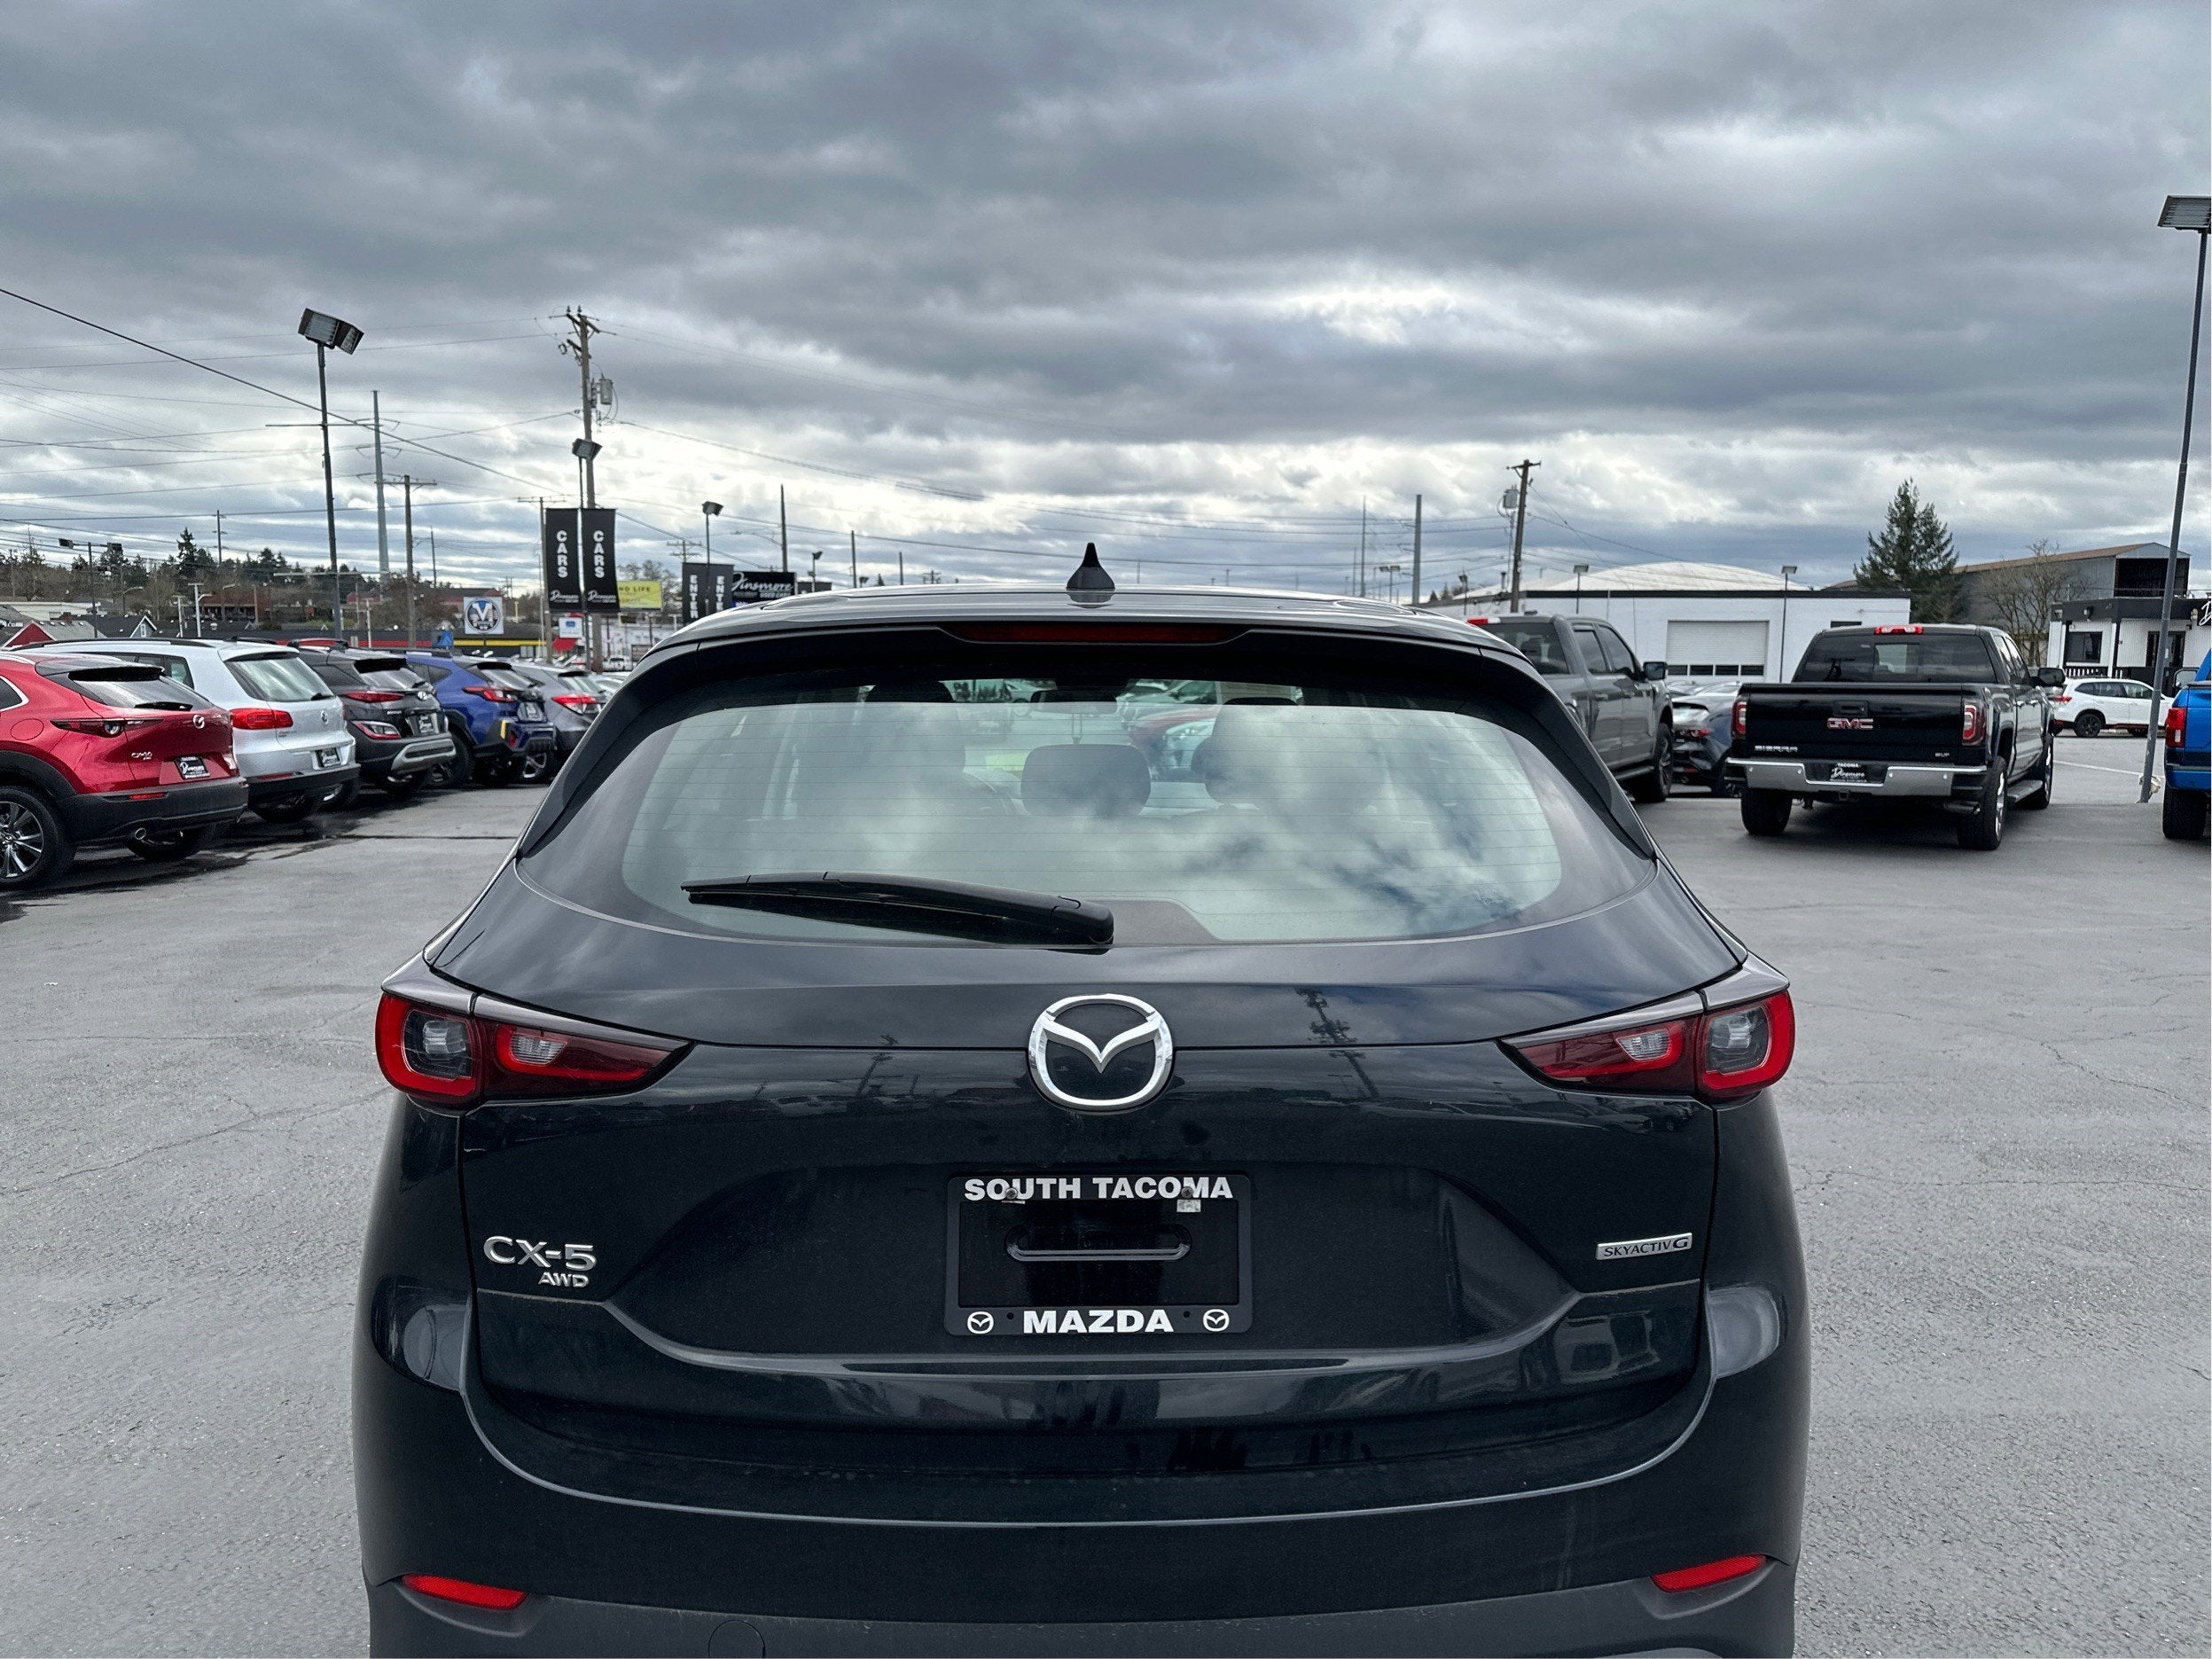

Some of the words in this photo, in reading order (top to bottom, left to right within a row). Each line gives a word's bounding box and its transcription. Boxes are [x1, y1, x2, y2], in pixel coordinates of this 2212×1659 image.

[556, 530, 568, 578] CARS
[593, 530, 605, 578] CARS
[690, 575, 699, 619] ENTER
[715, 575, 725, 611] ENTE
[1827, 717, 1873, 729] GMC
[965, 1178, 1081, 1201] SOUTH
[1092, 1177, 1232, 1199] TACOMA
[483, 1235, 598, 1272] CX-5
[538, 1272, 590, 1287] AWD
[1023, 1309, 1174, 1334] MAZDA
